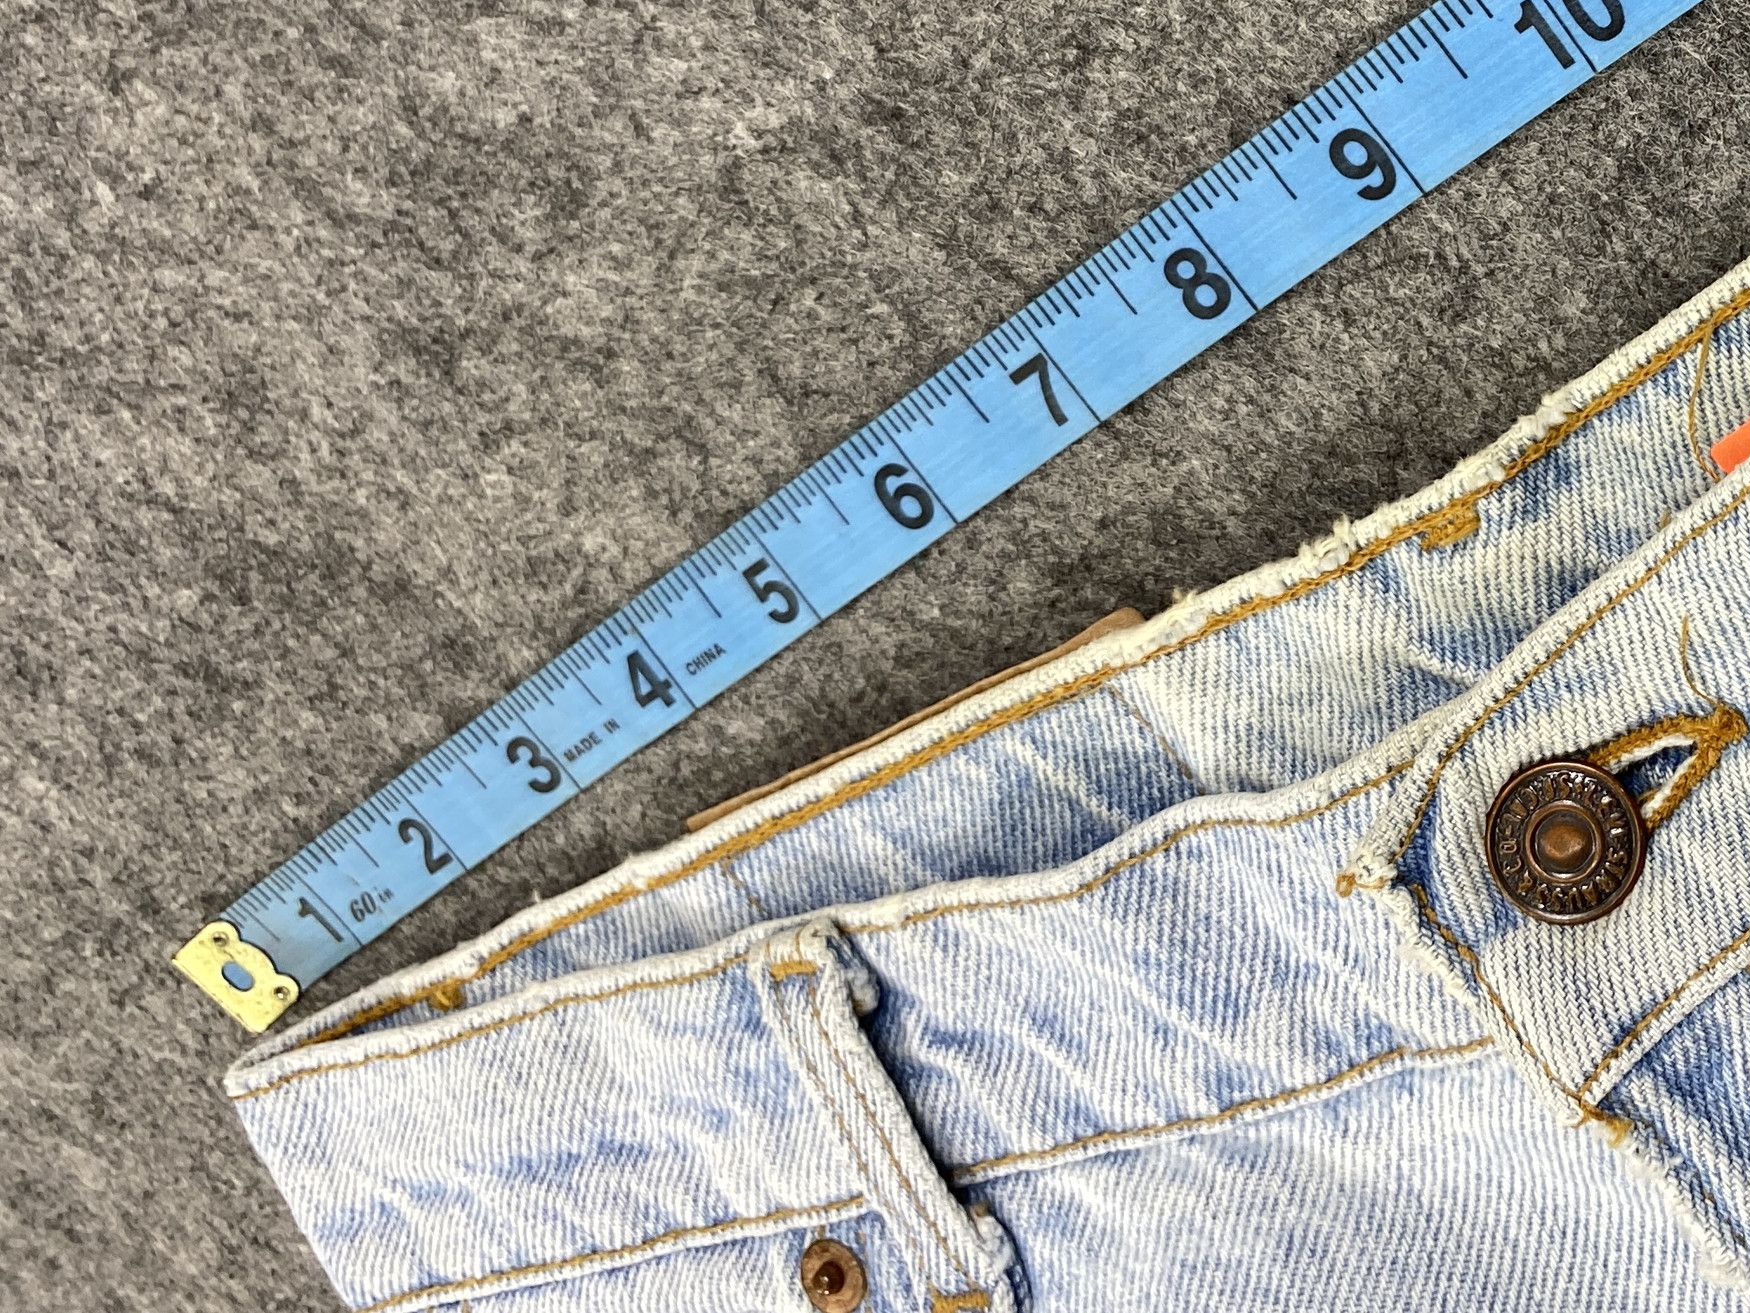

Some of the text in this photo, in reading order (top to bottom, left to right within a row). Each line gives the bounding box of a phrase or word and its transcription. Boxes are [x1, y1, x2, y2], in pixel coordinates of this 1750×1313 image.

[1328, 127, 1398, 201] 9
[1163, 246, 1232, 320] 8
[1008, 352, 1069, 427] 7
[873, 462, 935, 530] 6
[742, 557, 799, 624] 5
[563, 642, 726, 763] MADE IN CHINA
[626, 649, 677, 709] 4
[506, 736, 562, 794] 3
[398, 817, 454, 876] 2
[296, 897, 344, 944] 1
[350, 891, 377, 922] 60
